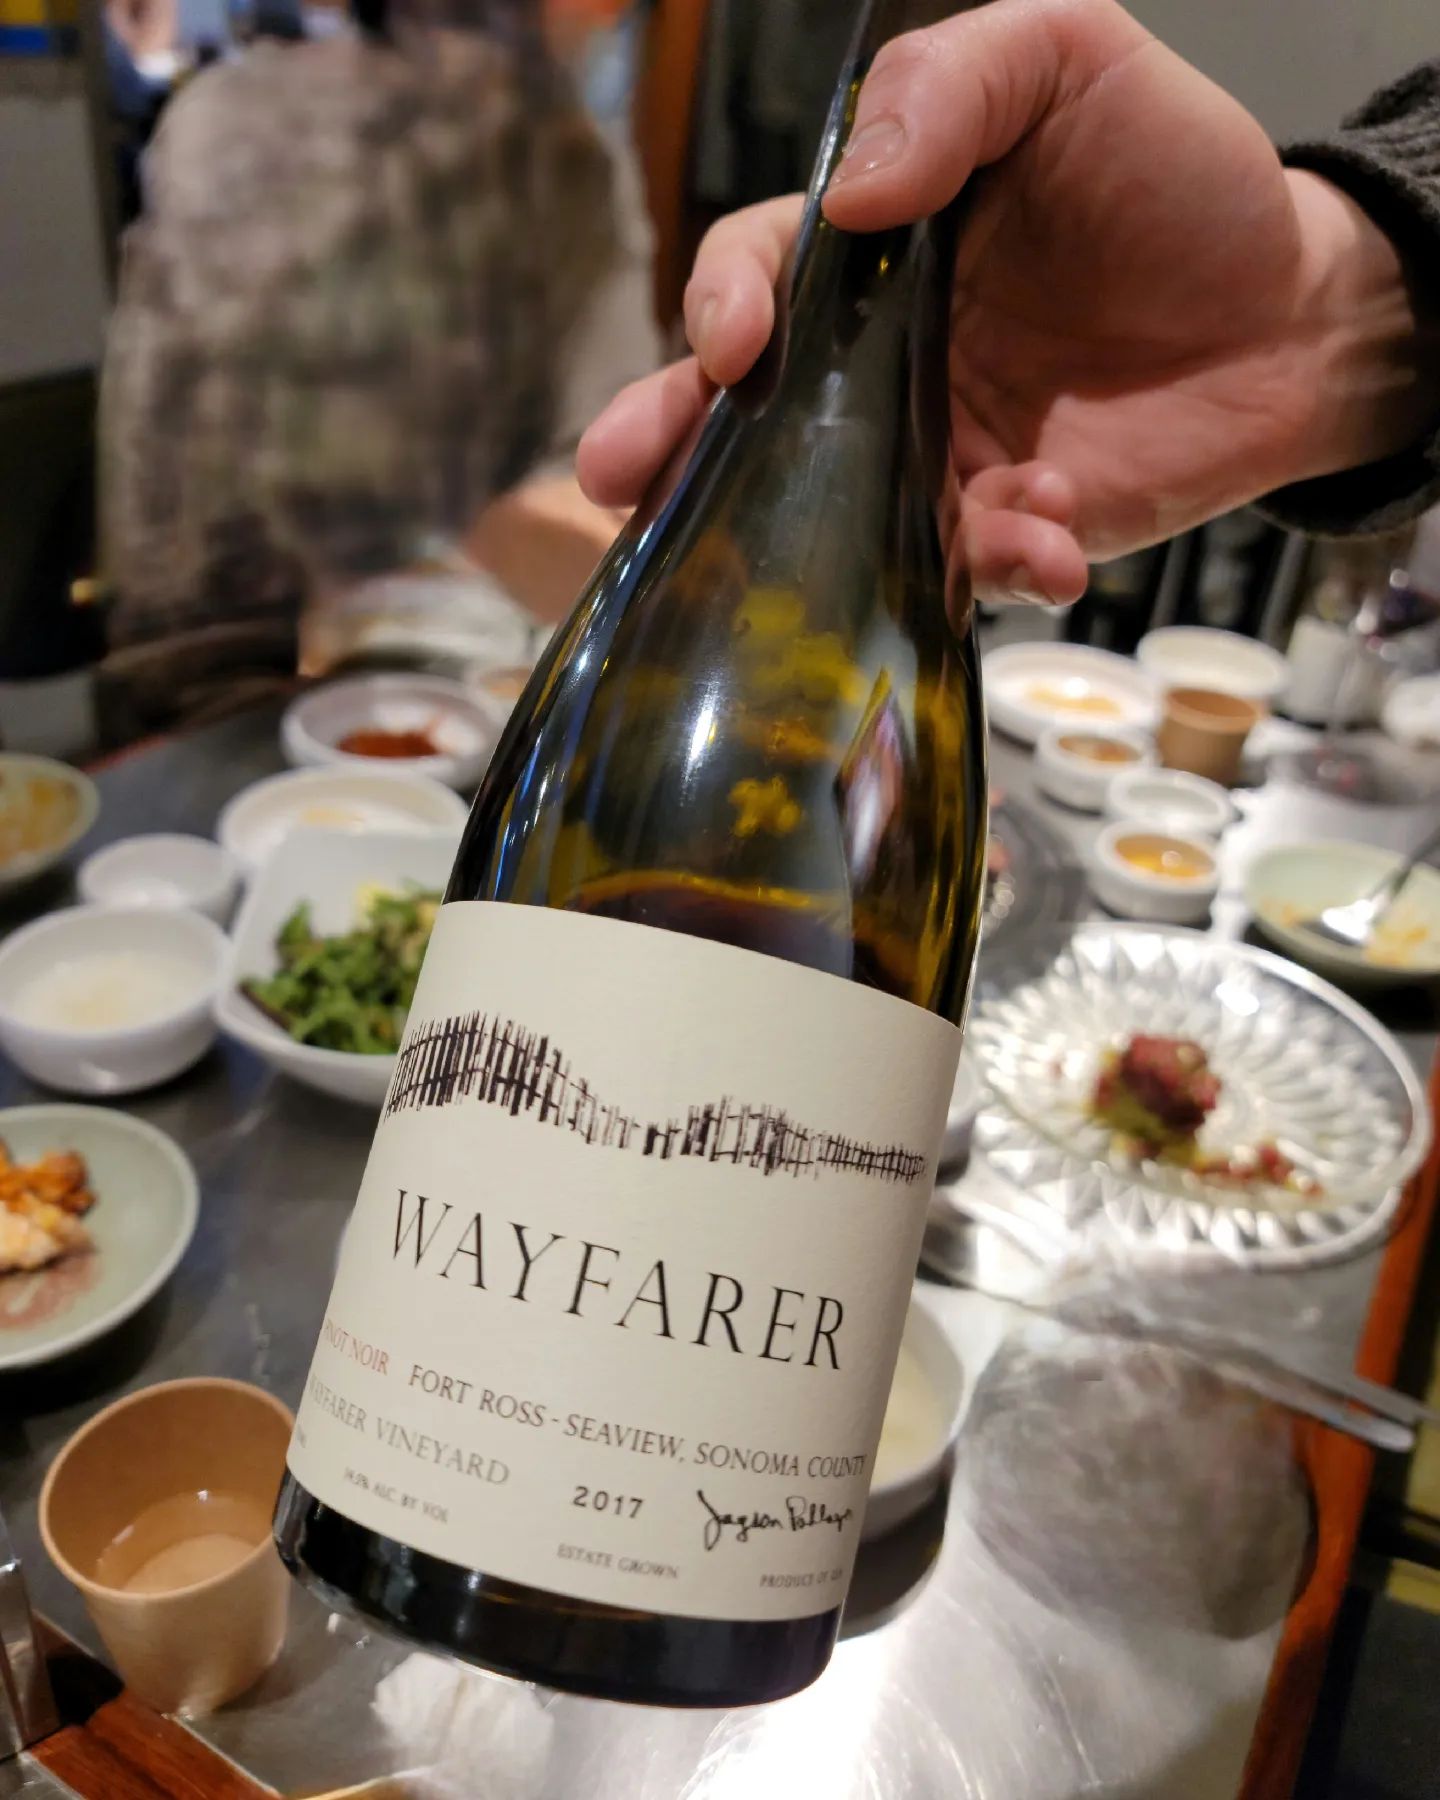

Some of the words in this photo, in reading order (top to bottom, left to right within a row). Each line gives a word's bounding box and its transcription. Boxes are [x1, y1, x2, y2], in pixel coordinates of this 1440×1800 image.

[392, 1189, 846, 1370] WAYFARER
[349, 1337, 390, 1375] NOIR
[408, 1365, 472, 1404] FORT
[479, 1389, 546, 1428] ROSS
[563, 1413, 686, 1463] SEAVIEW,
[694, 1442, 800, 1477] SONOMA
[807, 1454, 866, 1478] COUNTY
[376, 1417, 510, 1485] VINEYARD
[572, 1486, 644, 1519] 2017
[556, 1543, 613, 1569] ESTATE
[617, 1557, 679, 1580] GROWN
[759, 1573, 814, 1588] PRODUCT
